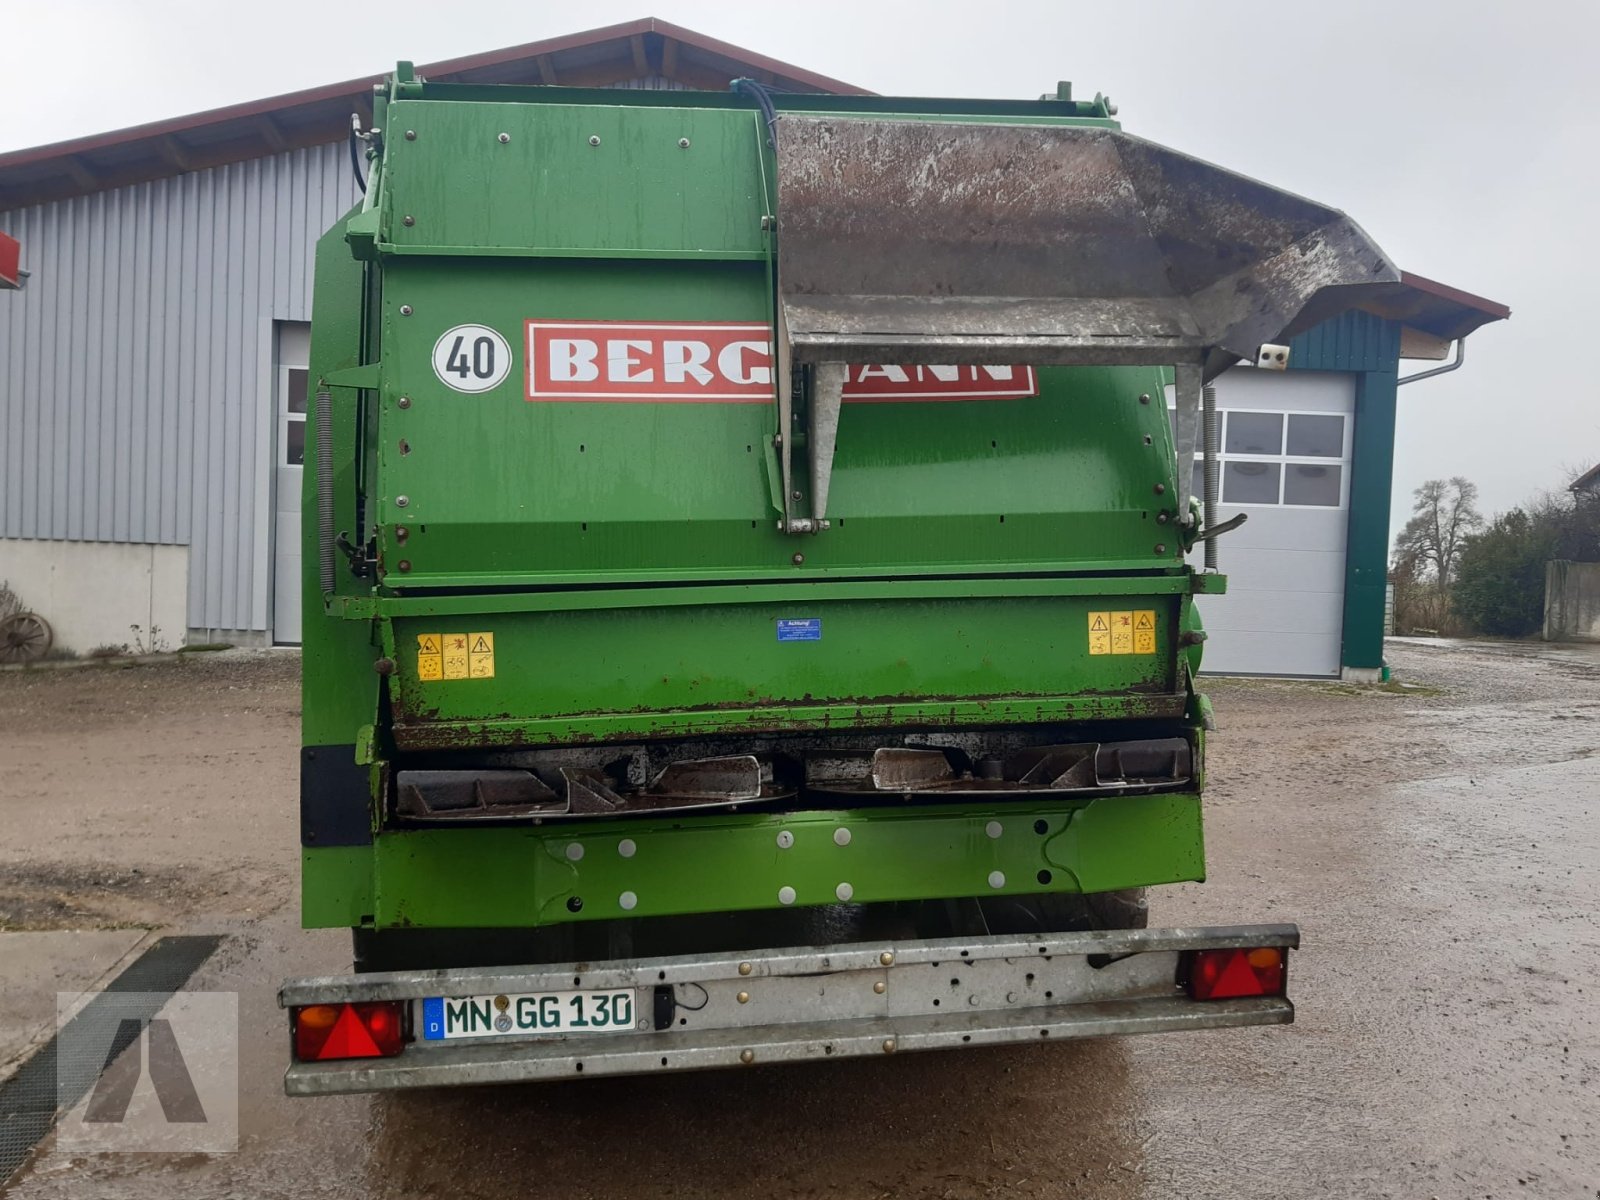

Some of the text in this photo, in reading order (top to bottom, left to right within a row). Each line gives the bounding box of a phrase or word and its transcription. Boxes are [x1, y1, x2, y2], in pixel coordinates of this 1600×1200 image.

[446, 336, 495, 379] 40
[430, 1022, 439, 1032] D
[446, 993, 632, 1033] MN GG 130
